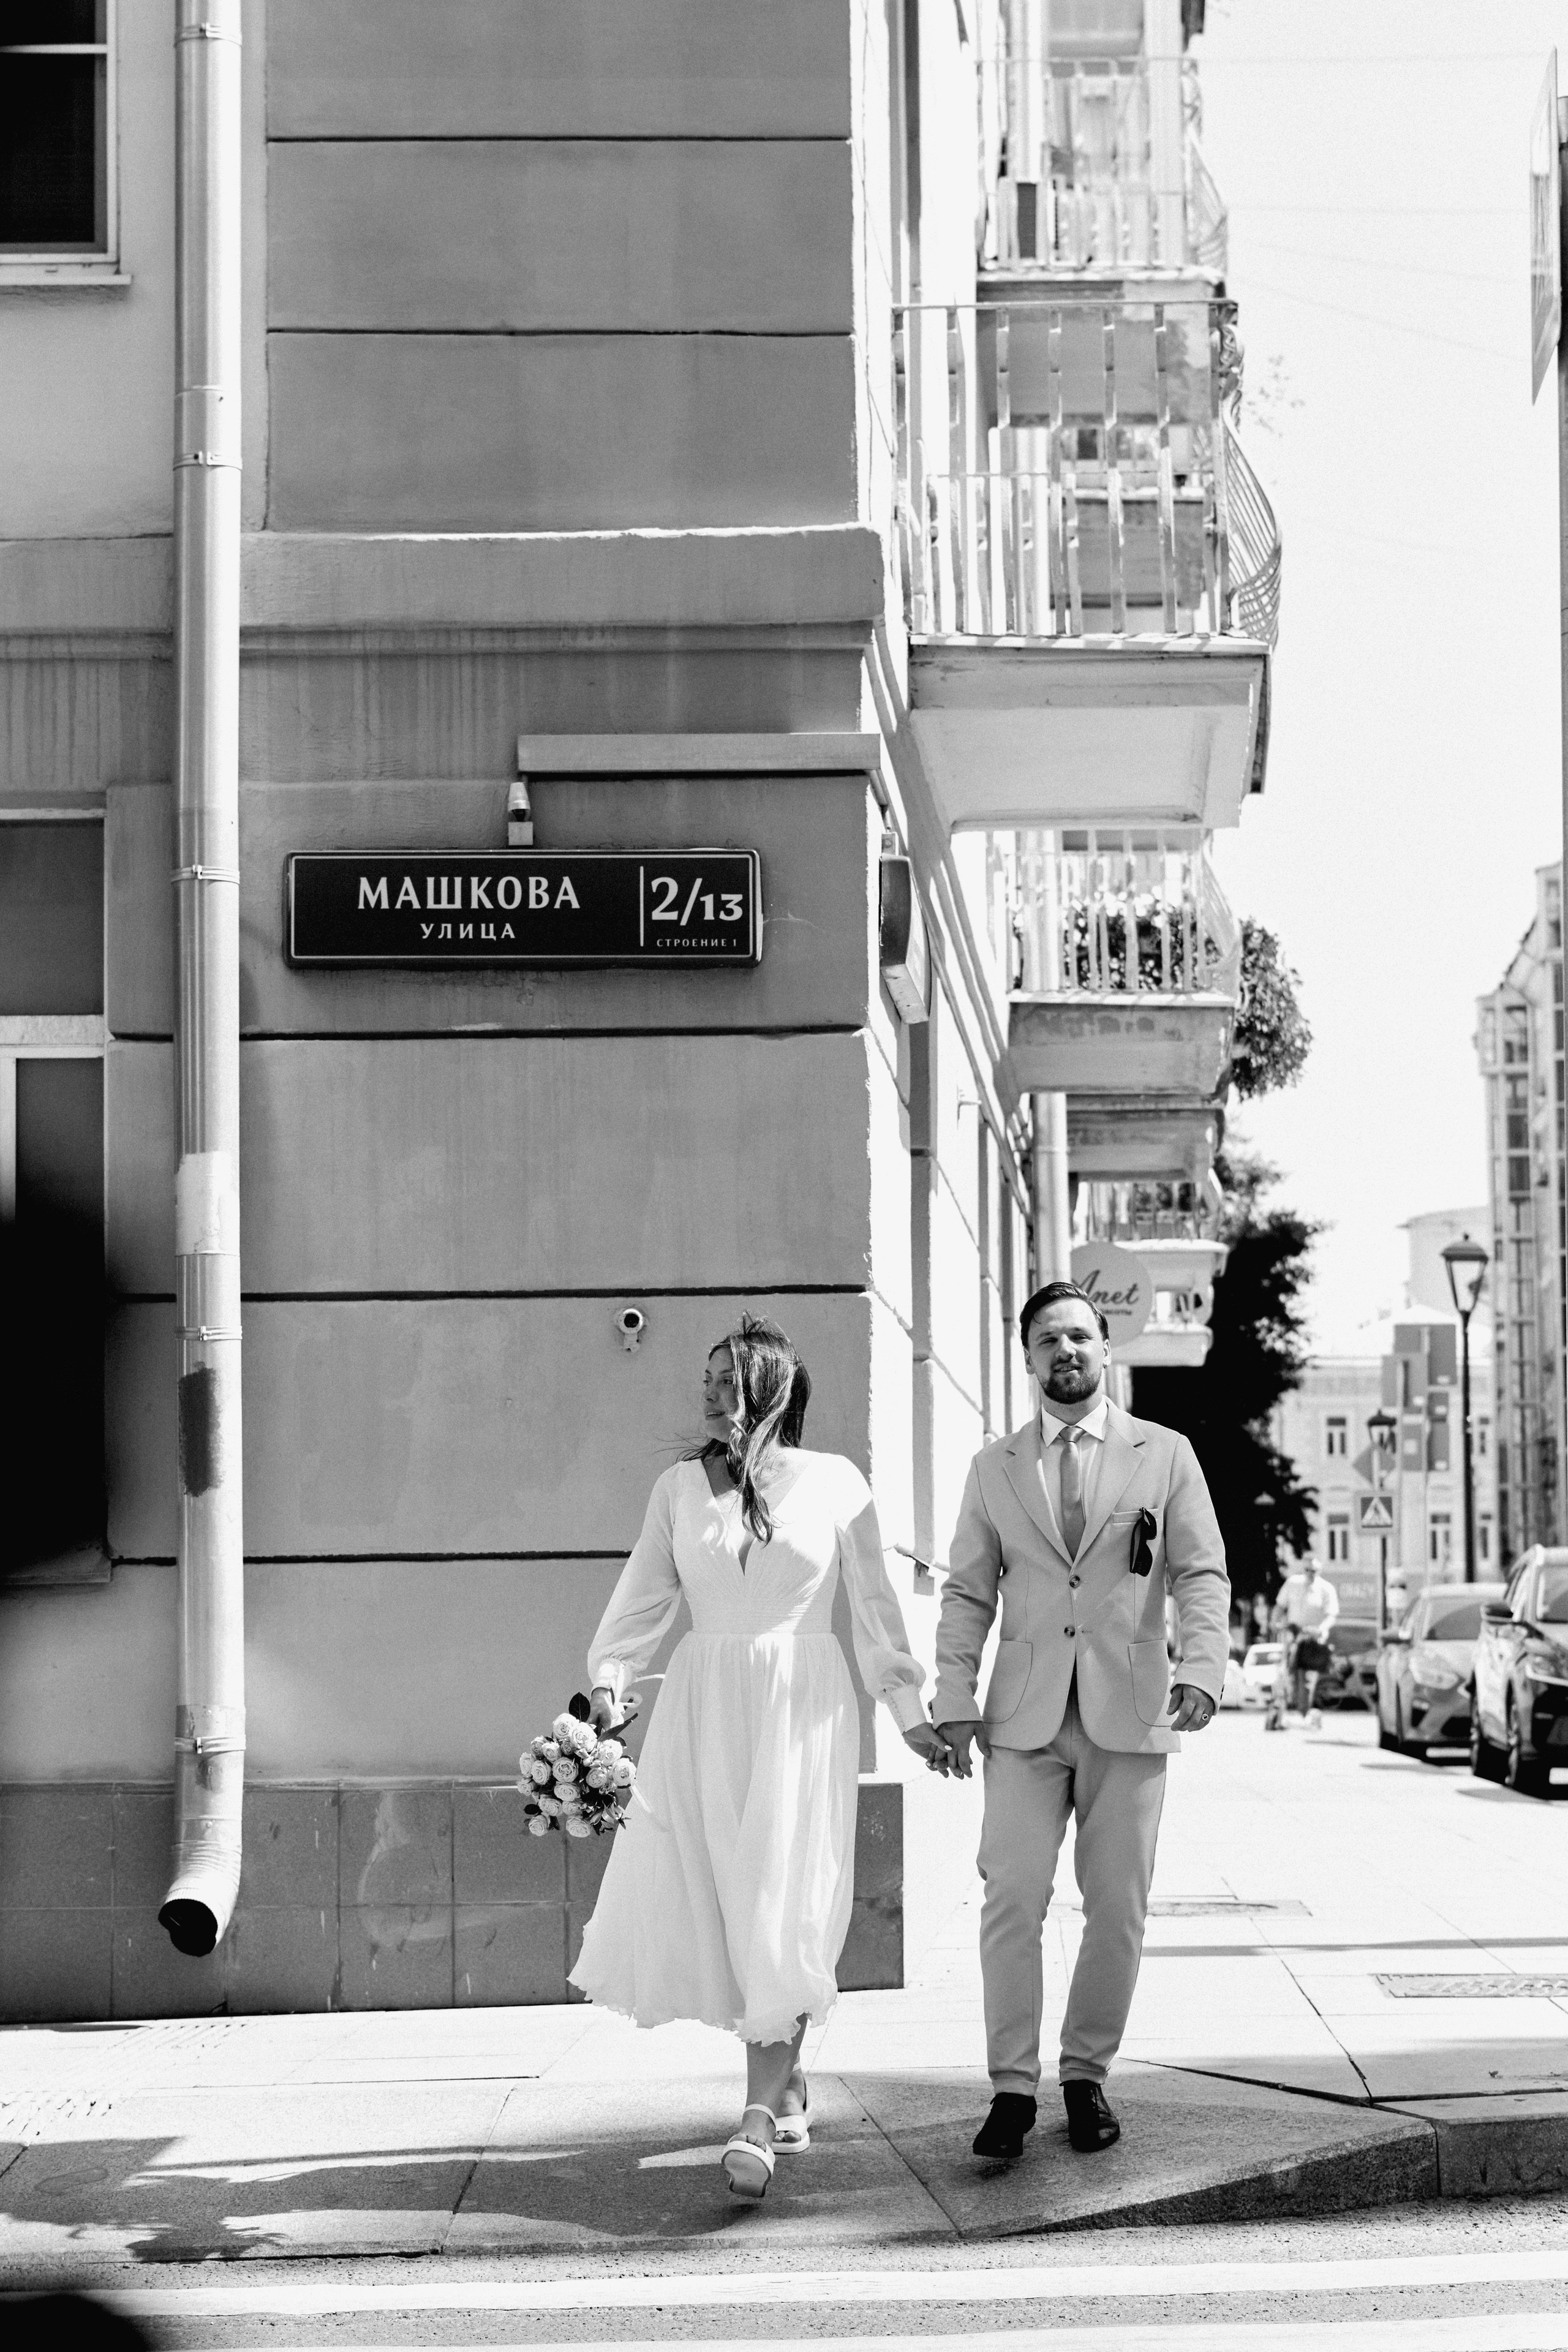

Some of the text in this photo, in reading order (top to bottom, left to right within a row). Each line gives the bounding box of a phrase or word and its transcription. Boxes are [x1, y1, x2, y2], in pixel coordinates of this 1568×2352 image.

[358, 876, 580, 910] МАШКОВА
[651, 876, 743, 926] 2/13
[420, 923, 515, 941] УЛИЦА
[1071, 1269, 1139, 1304] Anet
